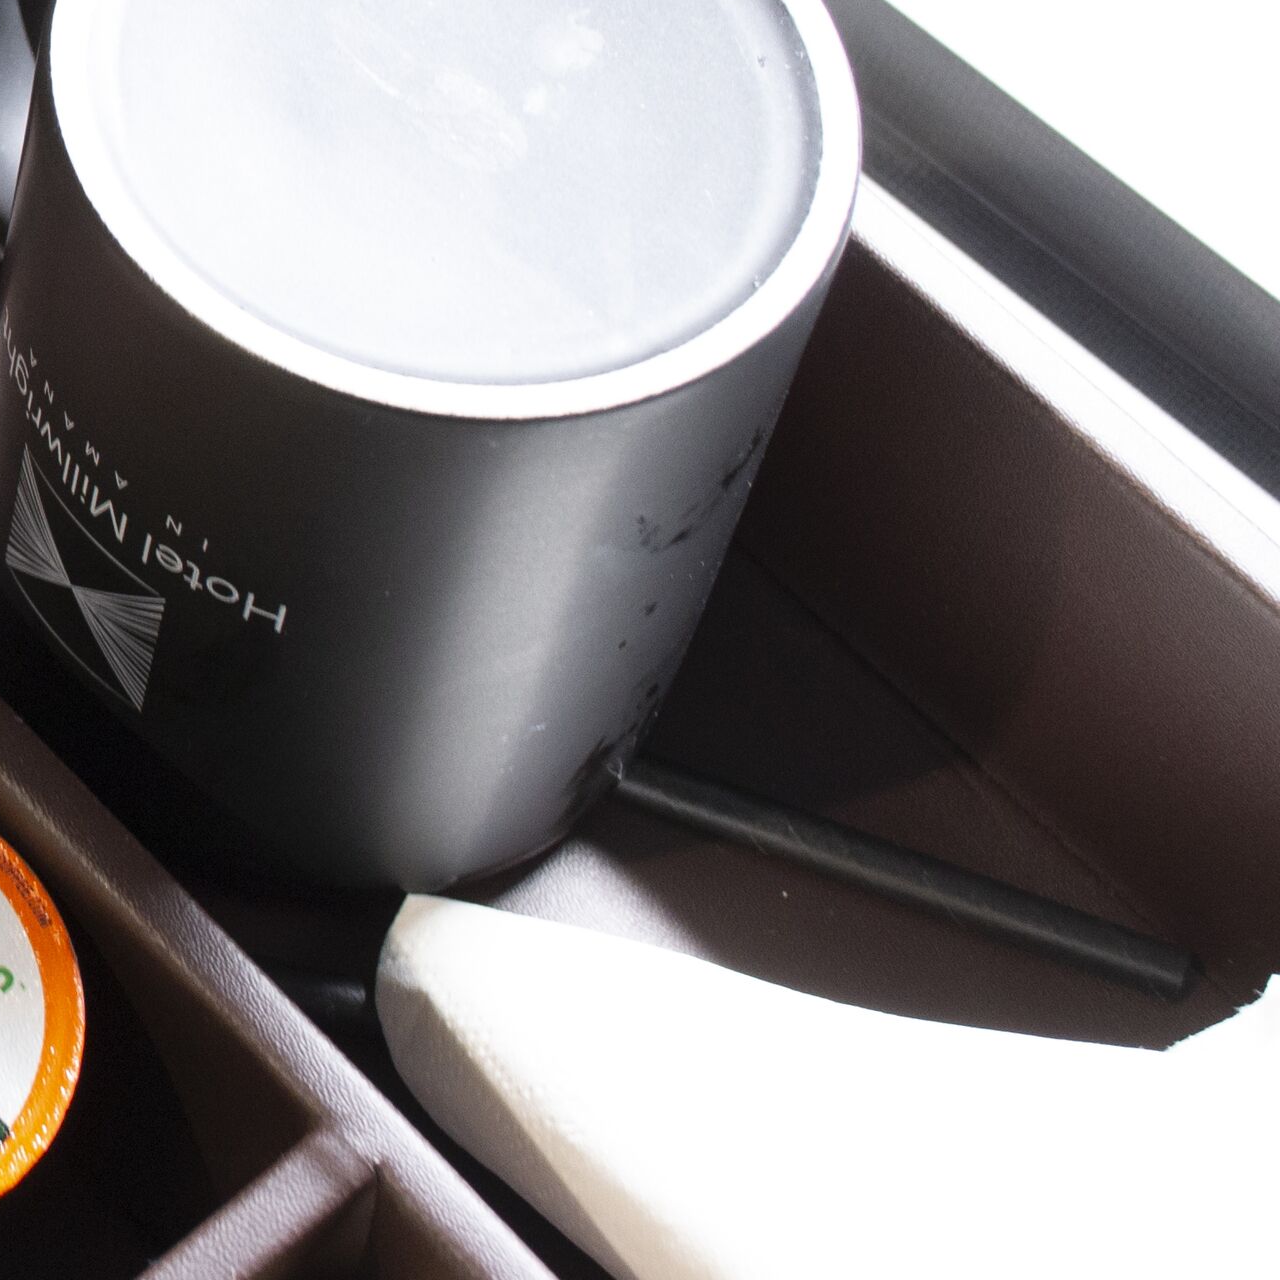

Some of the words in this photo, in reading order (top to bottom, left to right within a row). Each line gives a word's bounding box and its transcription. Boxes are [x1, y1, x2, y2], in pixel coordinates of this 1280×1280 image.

[4, 305, 128, 543] Millwright
[29, 346, 128, 490] AMANA
[142, 533, 287, 634] Hotel
[165, 514, 209, 552] IN
